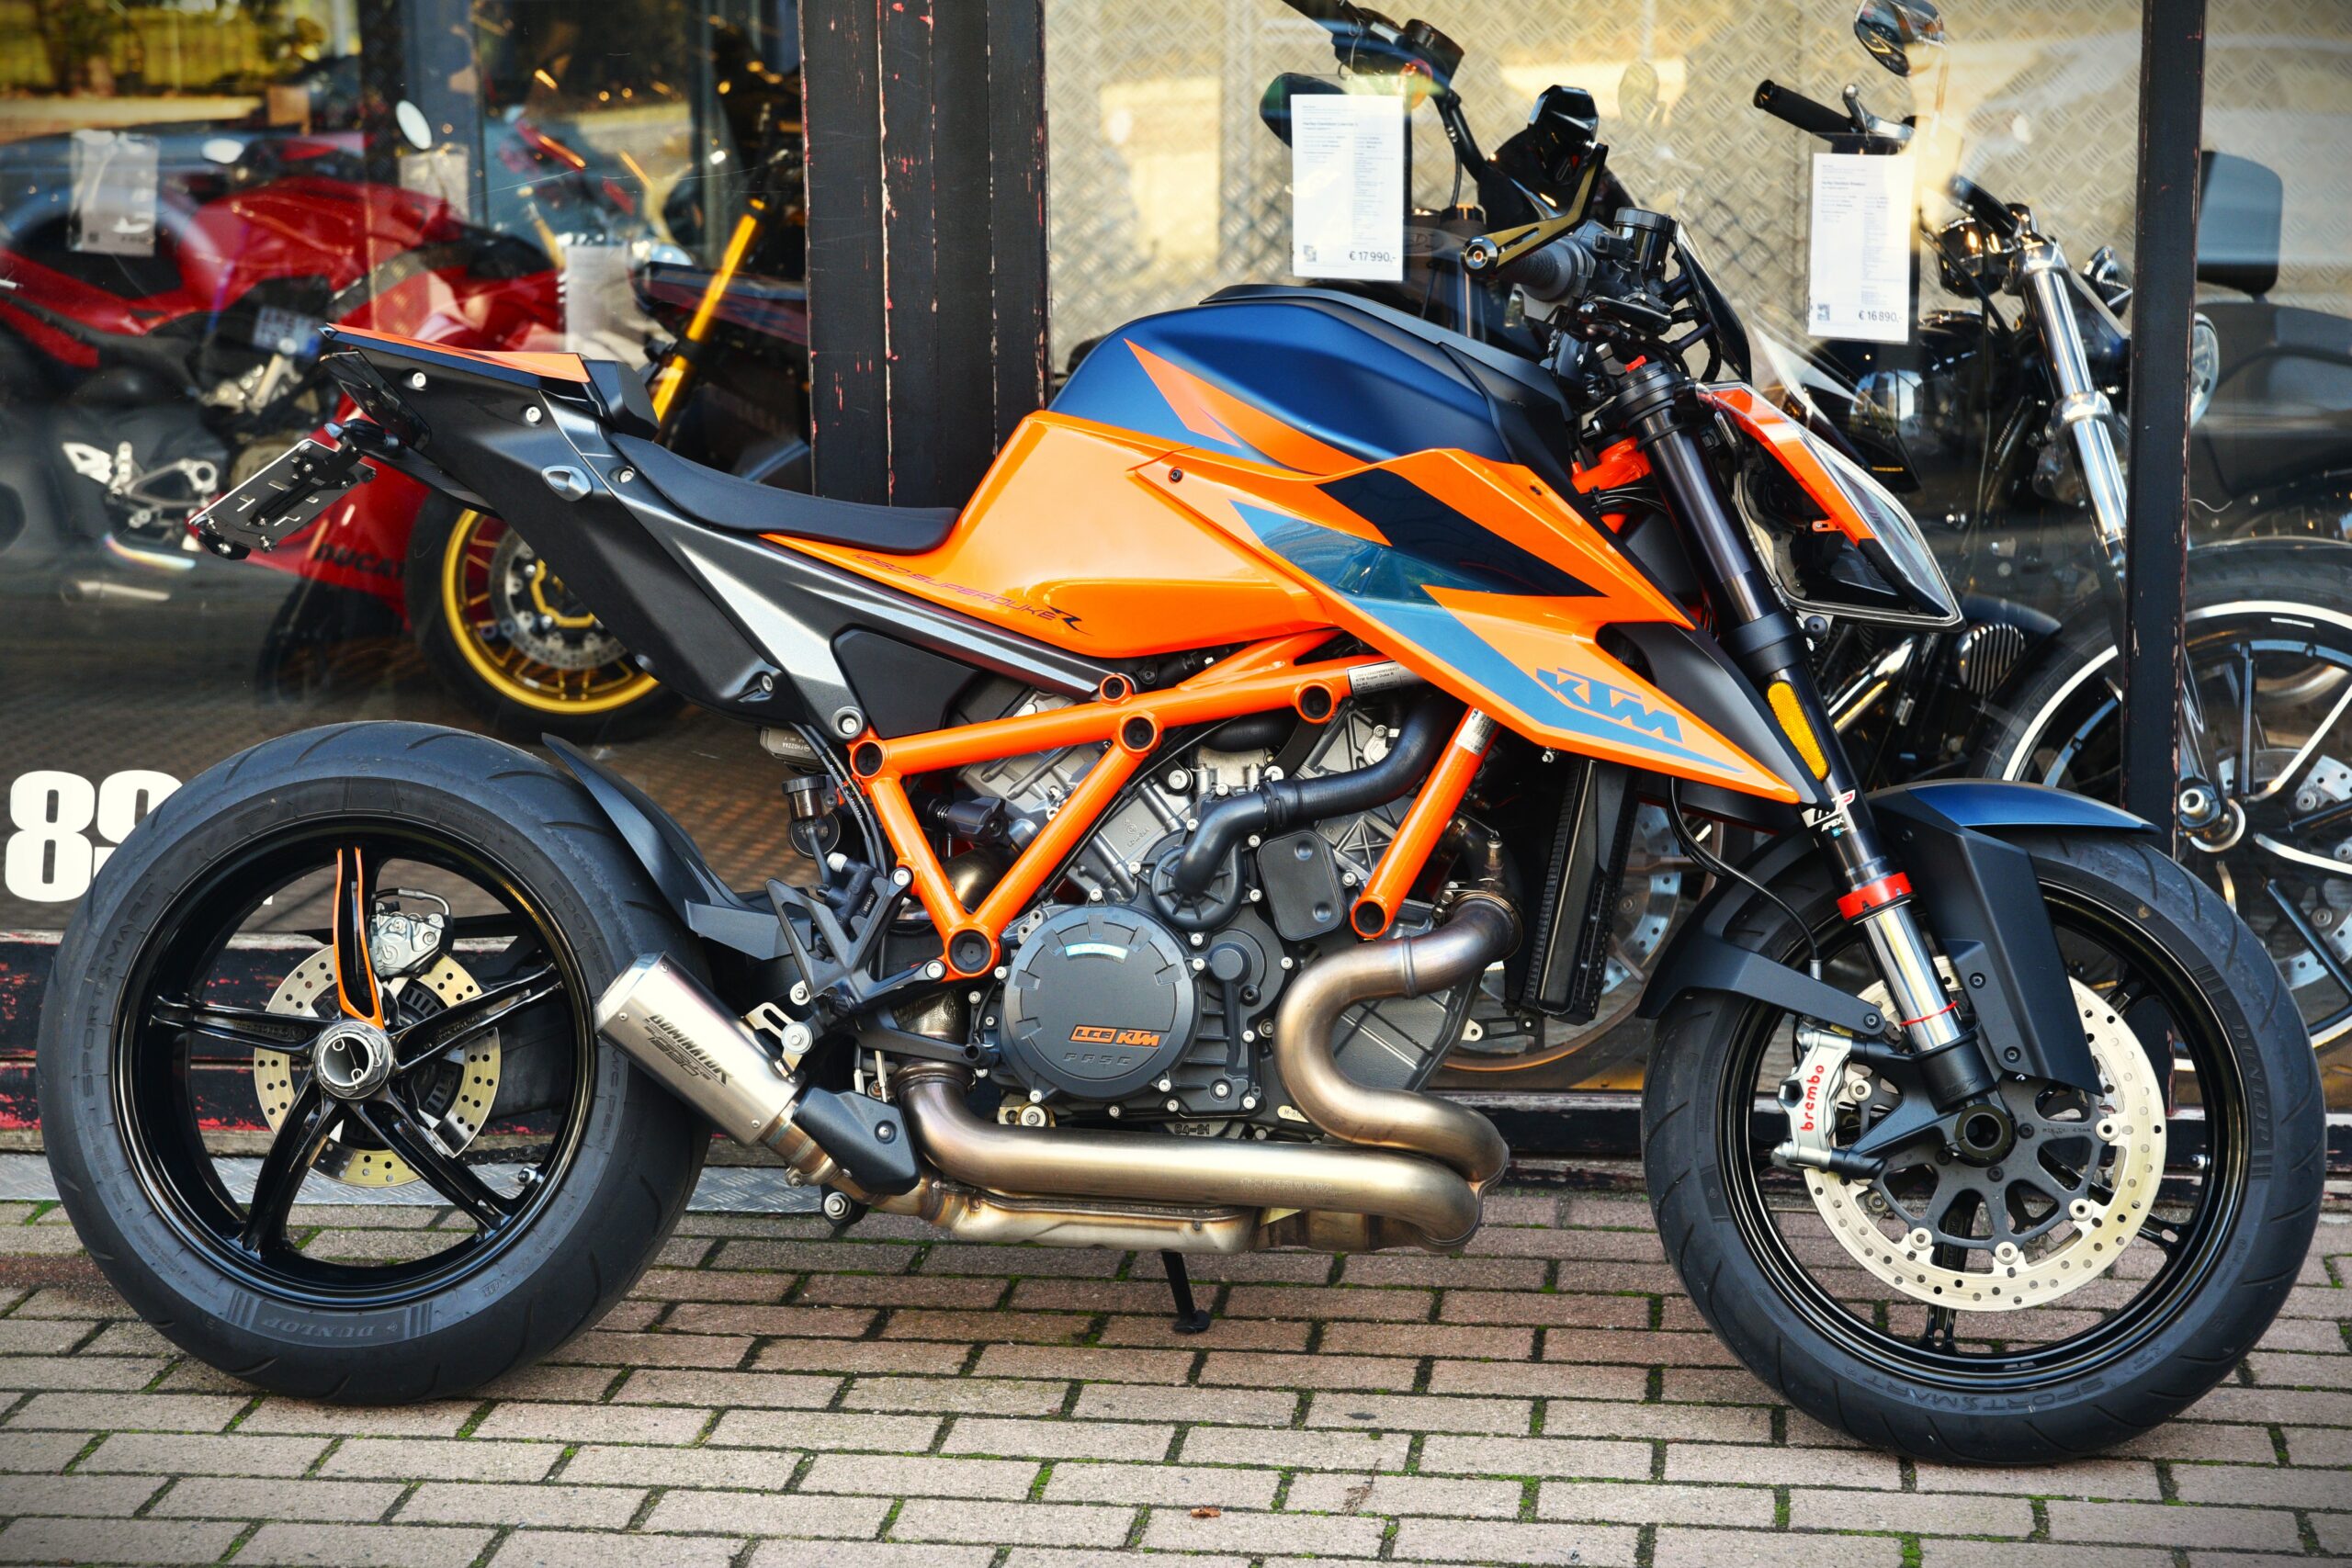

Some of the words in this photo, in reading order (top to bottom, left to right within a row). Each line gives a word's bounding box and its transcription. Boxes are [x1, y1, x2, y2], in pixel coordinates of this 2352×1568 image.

[314, 543, 406, 579] DUCAT
[1536, 667, 1683, 744] KTM
[1116, 1030, 1160, 1047] KTM
[1800, 1065, 1825, 1131] brembo
